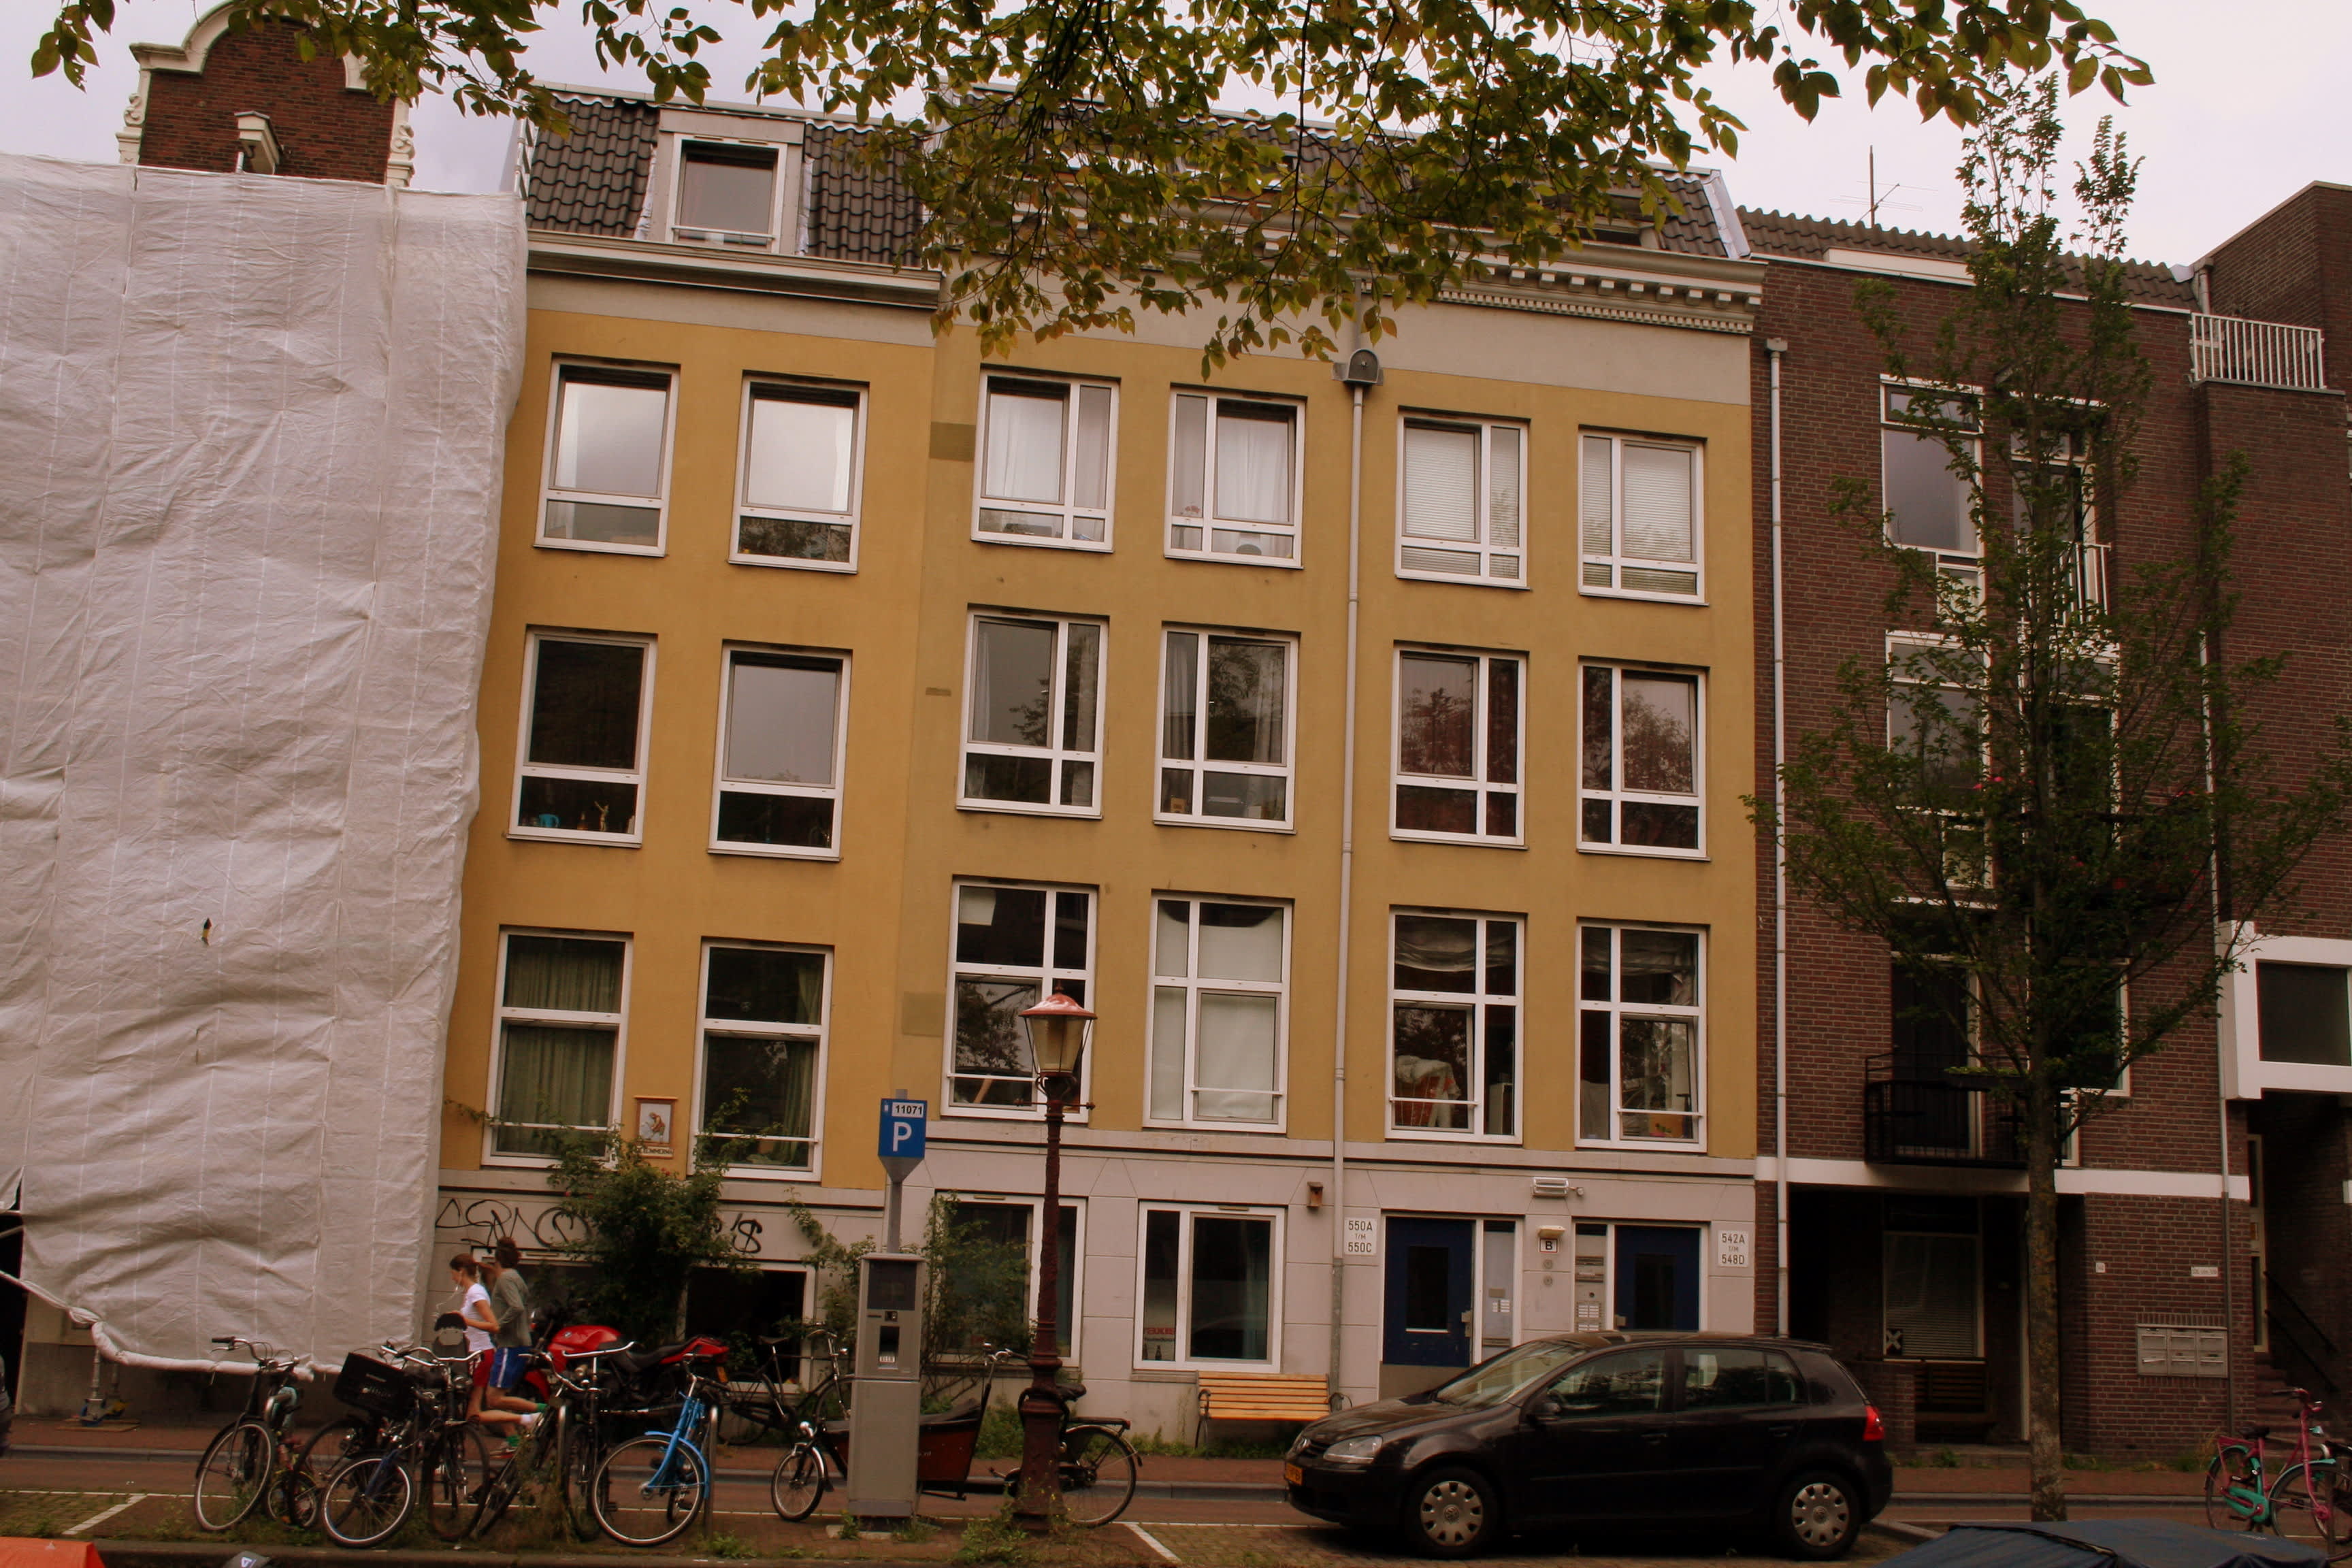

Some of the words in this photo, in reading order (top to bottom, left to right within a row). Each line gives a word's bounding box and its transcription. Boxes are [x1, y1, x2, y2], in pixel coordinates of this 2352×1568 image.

[896, 1105, 922, 1115] 11071
[892, 1122, 912, 1152] P
[1349, 1220, 1373, 1231] 550A
[1722, 1232, 1746, 1244] 542A
[1348, 1241, 1372, 1253] 550C
[1545, 1241, 1552, 1250] B
[1722, 1254, 1745, 1264] 548D
